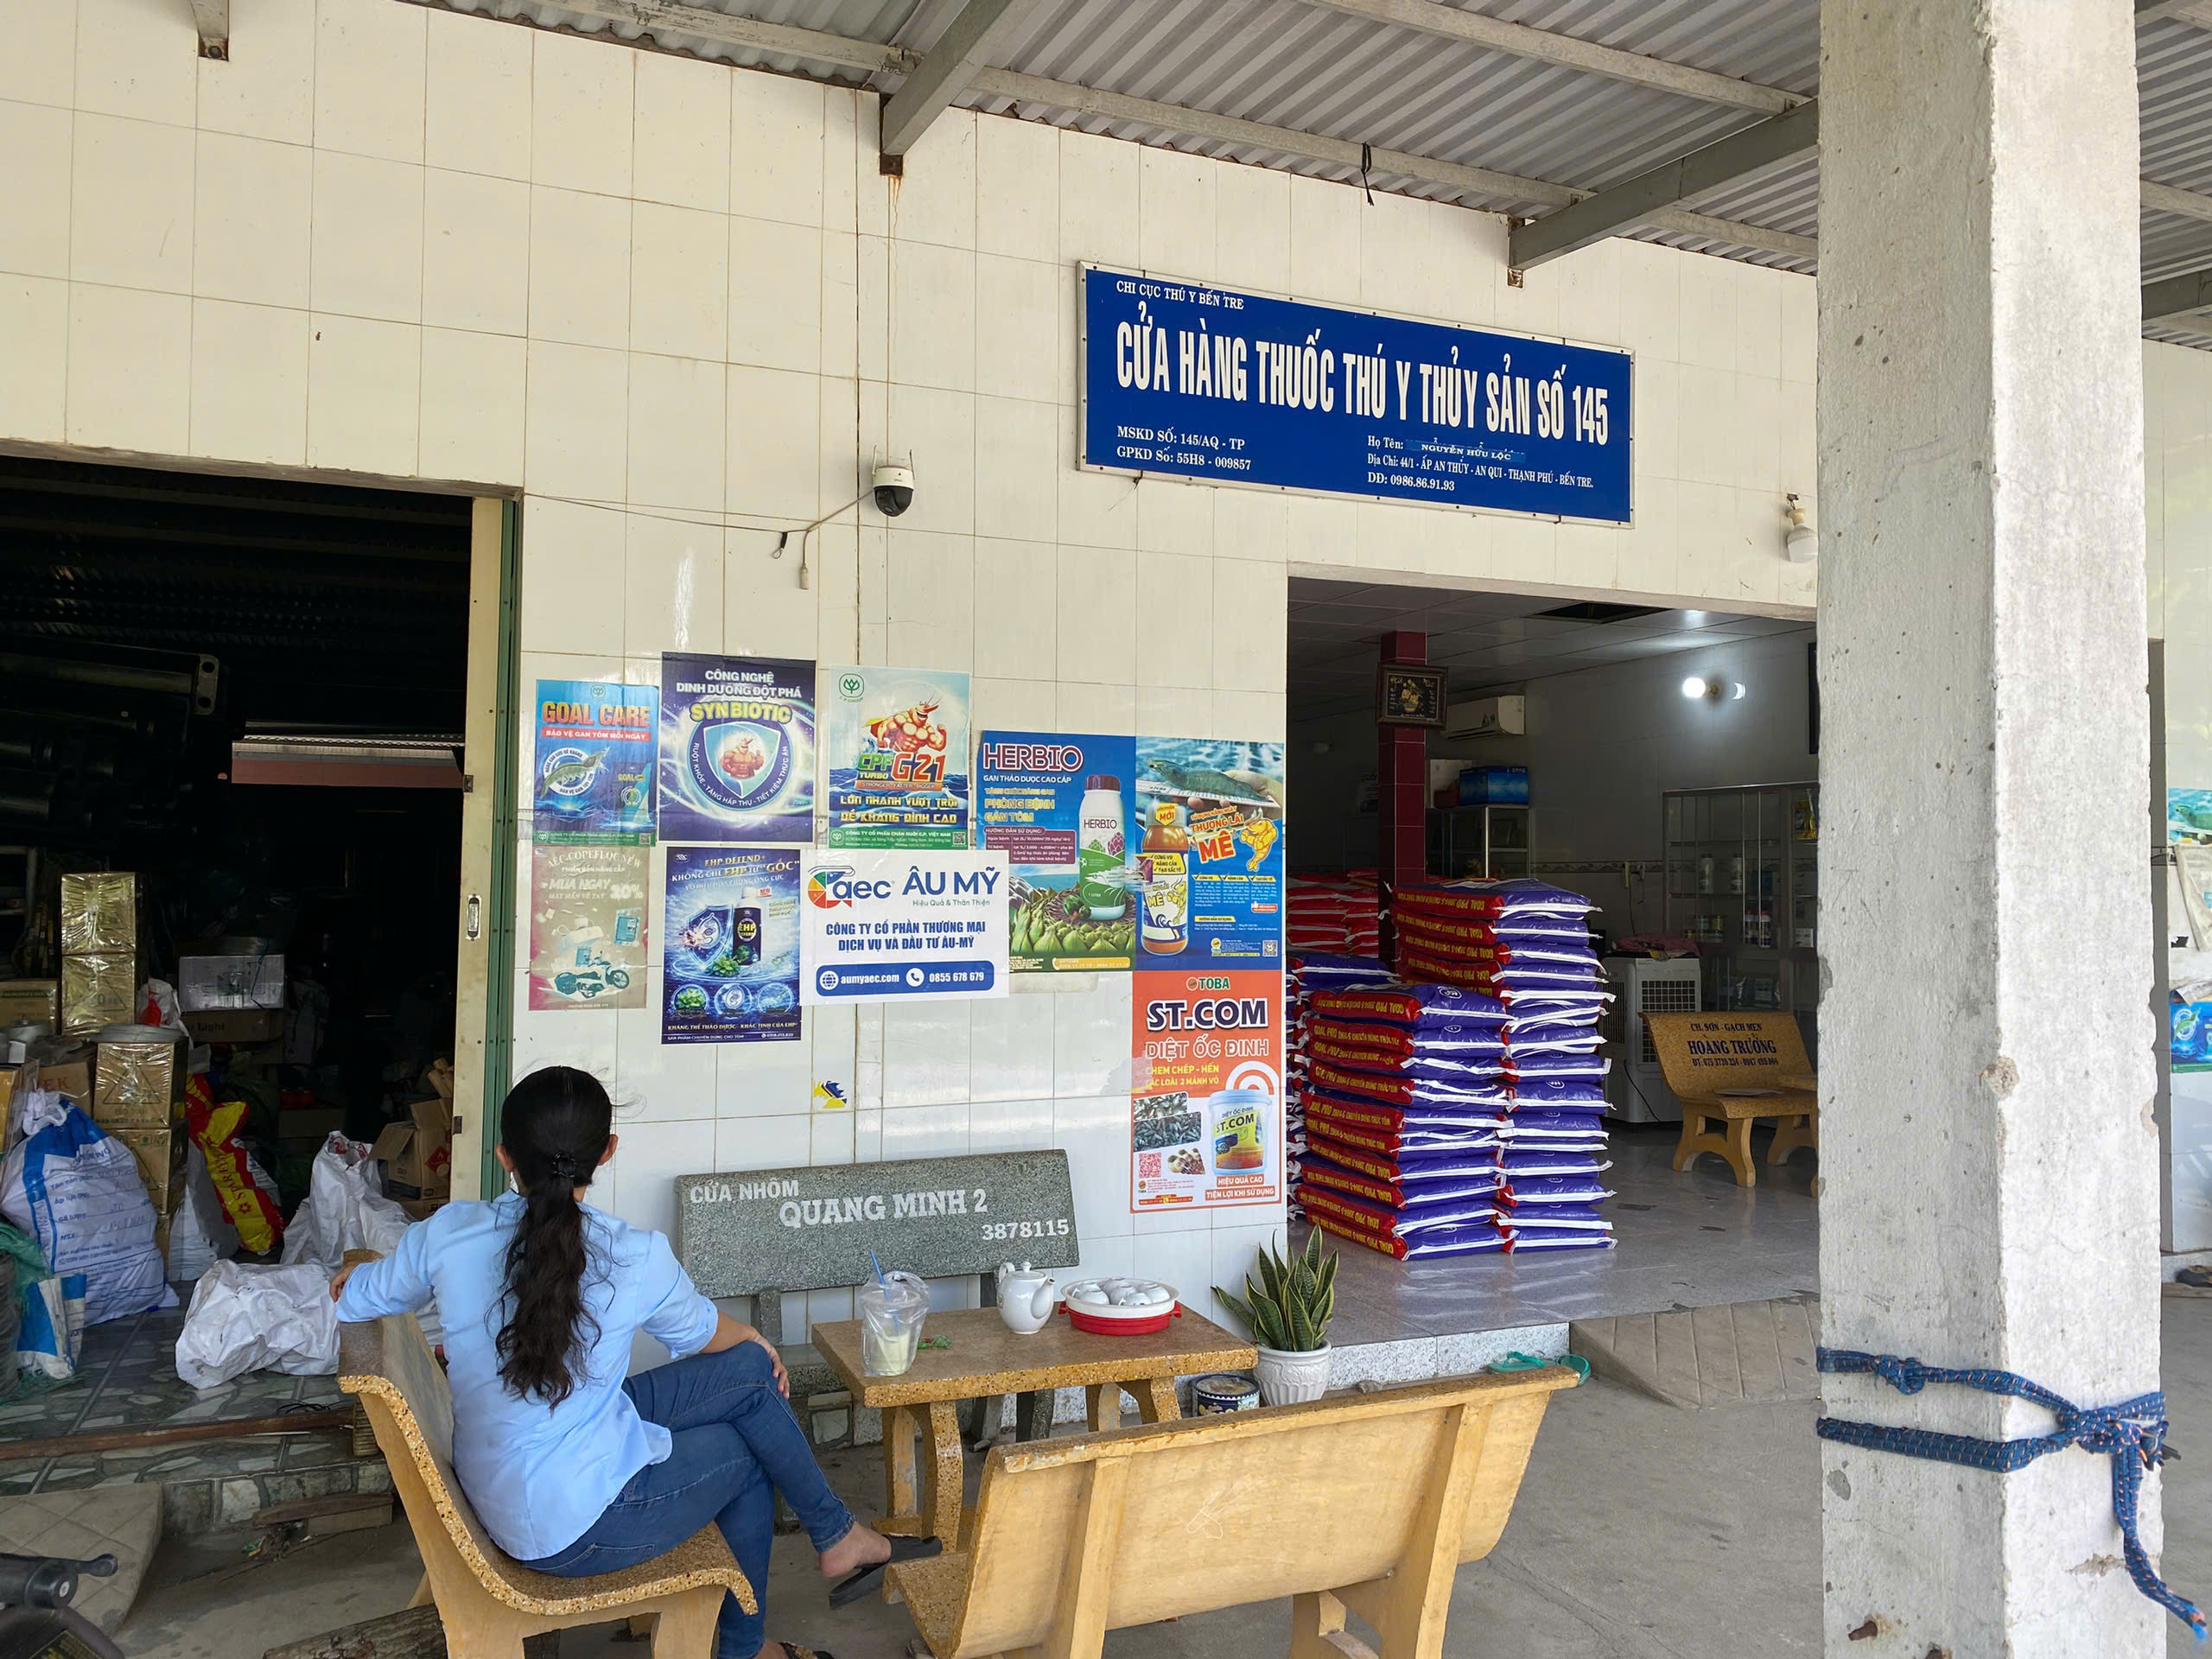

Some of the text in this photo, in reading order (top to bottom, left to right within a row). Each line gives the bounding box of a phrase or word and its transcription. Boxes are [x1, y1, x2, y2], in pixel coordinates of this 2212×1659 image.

[1116, 280, 1244, 310] CHI CỤC THÚ Y BẾN TRE
[1116, 301, 1608, 446] CỬA HÀNG THUỐC THÚ Y THỦY SẢN SỐ 145
[1116, 425, 1245, 450] MSKD SỐ: 145/AQ TP
[1368, 435, 1381, 449] Họ
[1383, 437, 1403, 449] Tên:
[1116, 445, 1153, 461] GPKD
[1177, 451, 1205, 467] 55H8
[1215, 454, 1251, 470] 009857
[1368, 453, 1381, 467] Địa
[1400, 456, 1414, 468] 44/1
[1421, 454, 1433, 470] ẤP
[1433, 460, 1446, 472] AN
[1475, 465, 1486, 475] AN
[1488, 467, 1502, 479] QUI
[1509, 468, 1535, 482] THẠNH
[1537, 470, 1554, 484] PHÚ
[1559, 470, 1575, 486] BẾN
[1577, 476, 1593, 487] TRE.
[1390, 474, 1455, 491] 0986.86.91.93
[705, 668, 774, 685] CÔNG NGHỆ
[676, 682, 802, 700] DINH DƯỠNG ĐỘT PHÁ
[543, 701, 651, 728] GOAL CARE
[982, 743, 1084, 772] HERBIO
[857, 752, 947, 782] CPF G21
[1057, 774, 1071, 784] CẤP
[1009, 810, 1035, 823] TÔM
[1084, 819, 1117, 830] HERBIO
[1160, 812, 1175, 821] MỚI
[1189, 812, 1244, 833] THƯƠNG LÁI
[1198, 830, 1236, 864] MÊ
[705, 857, 722, 868] EHP
[833, 866, 1001, 899] aec ÂU MỸ
[912, 899, 928, 907] Hiệu
[930, 899, 945, 907] Quả
[971, 899, 990, 907] Thiện
[1147, 893, 1165, 907] MÊ
[1456, 899, 1484, 911] GOAL PRO
[826, 919, 986, 936] CÔNG TY CỔ PHẦN THƯƠNG MẠI
[838, 935, 975, 954] DỊCH VỤ VÀ ĐẦU TƯ ÂU-MỸ
[841, 974, 899, 985] aumyaec.com
[929, 971, 985, 982] 0855 678 679
[1198, 977, 1230, 990] TOBA
[1147, 997, 1268, 1030] ST.COM
[1376, 1002, 1405, 1014] GOAL PRO
[1747, 1023, 1763, 1032] MEN
[1145, 1033, 1269, 1063] DIỆT ỐC ĐINH
[1687, 1033, 1777, 1054] HOÀNG TRƯỞNG
[1173, 1061, 1218, 1075] CHÉP HẾN
[1217, 1113, 1254, 1134] ST.COM
[1218, 1175, 1263, 1187] HIỆU QUẢ CAO
[690, 1176, 800, 1205] CỬA NHÔM
[1206, 1191, 1222, 1199] TIỆN
[1223, 1189, 1234, 1198] LỢI
[1235, 1189, 1246, 1198] KHI
[1256, 1187, 1274, 1197] DỤNG
[779, 1188, 988, 1229] QUANG MINH 2
[981, 1218, 1070, 1243] 3878115
[1366, 1237, 1395, 1255] GOAL PRO
